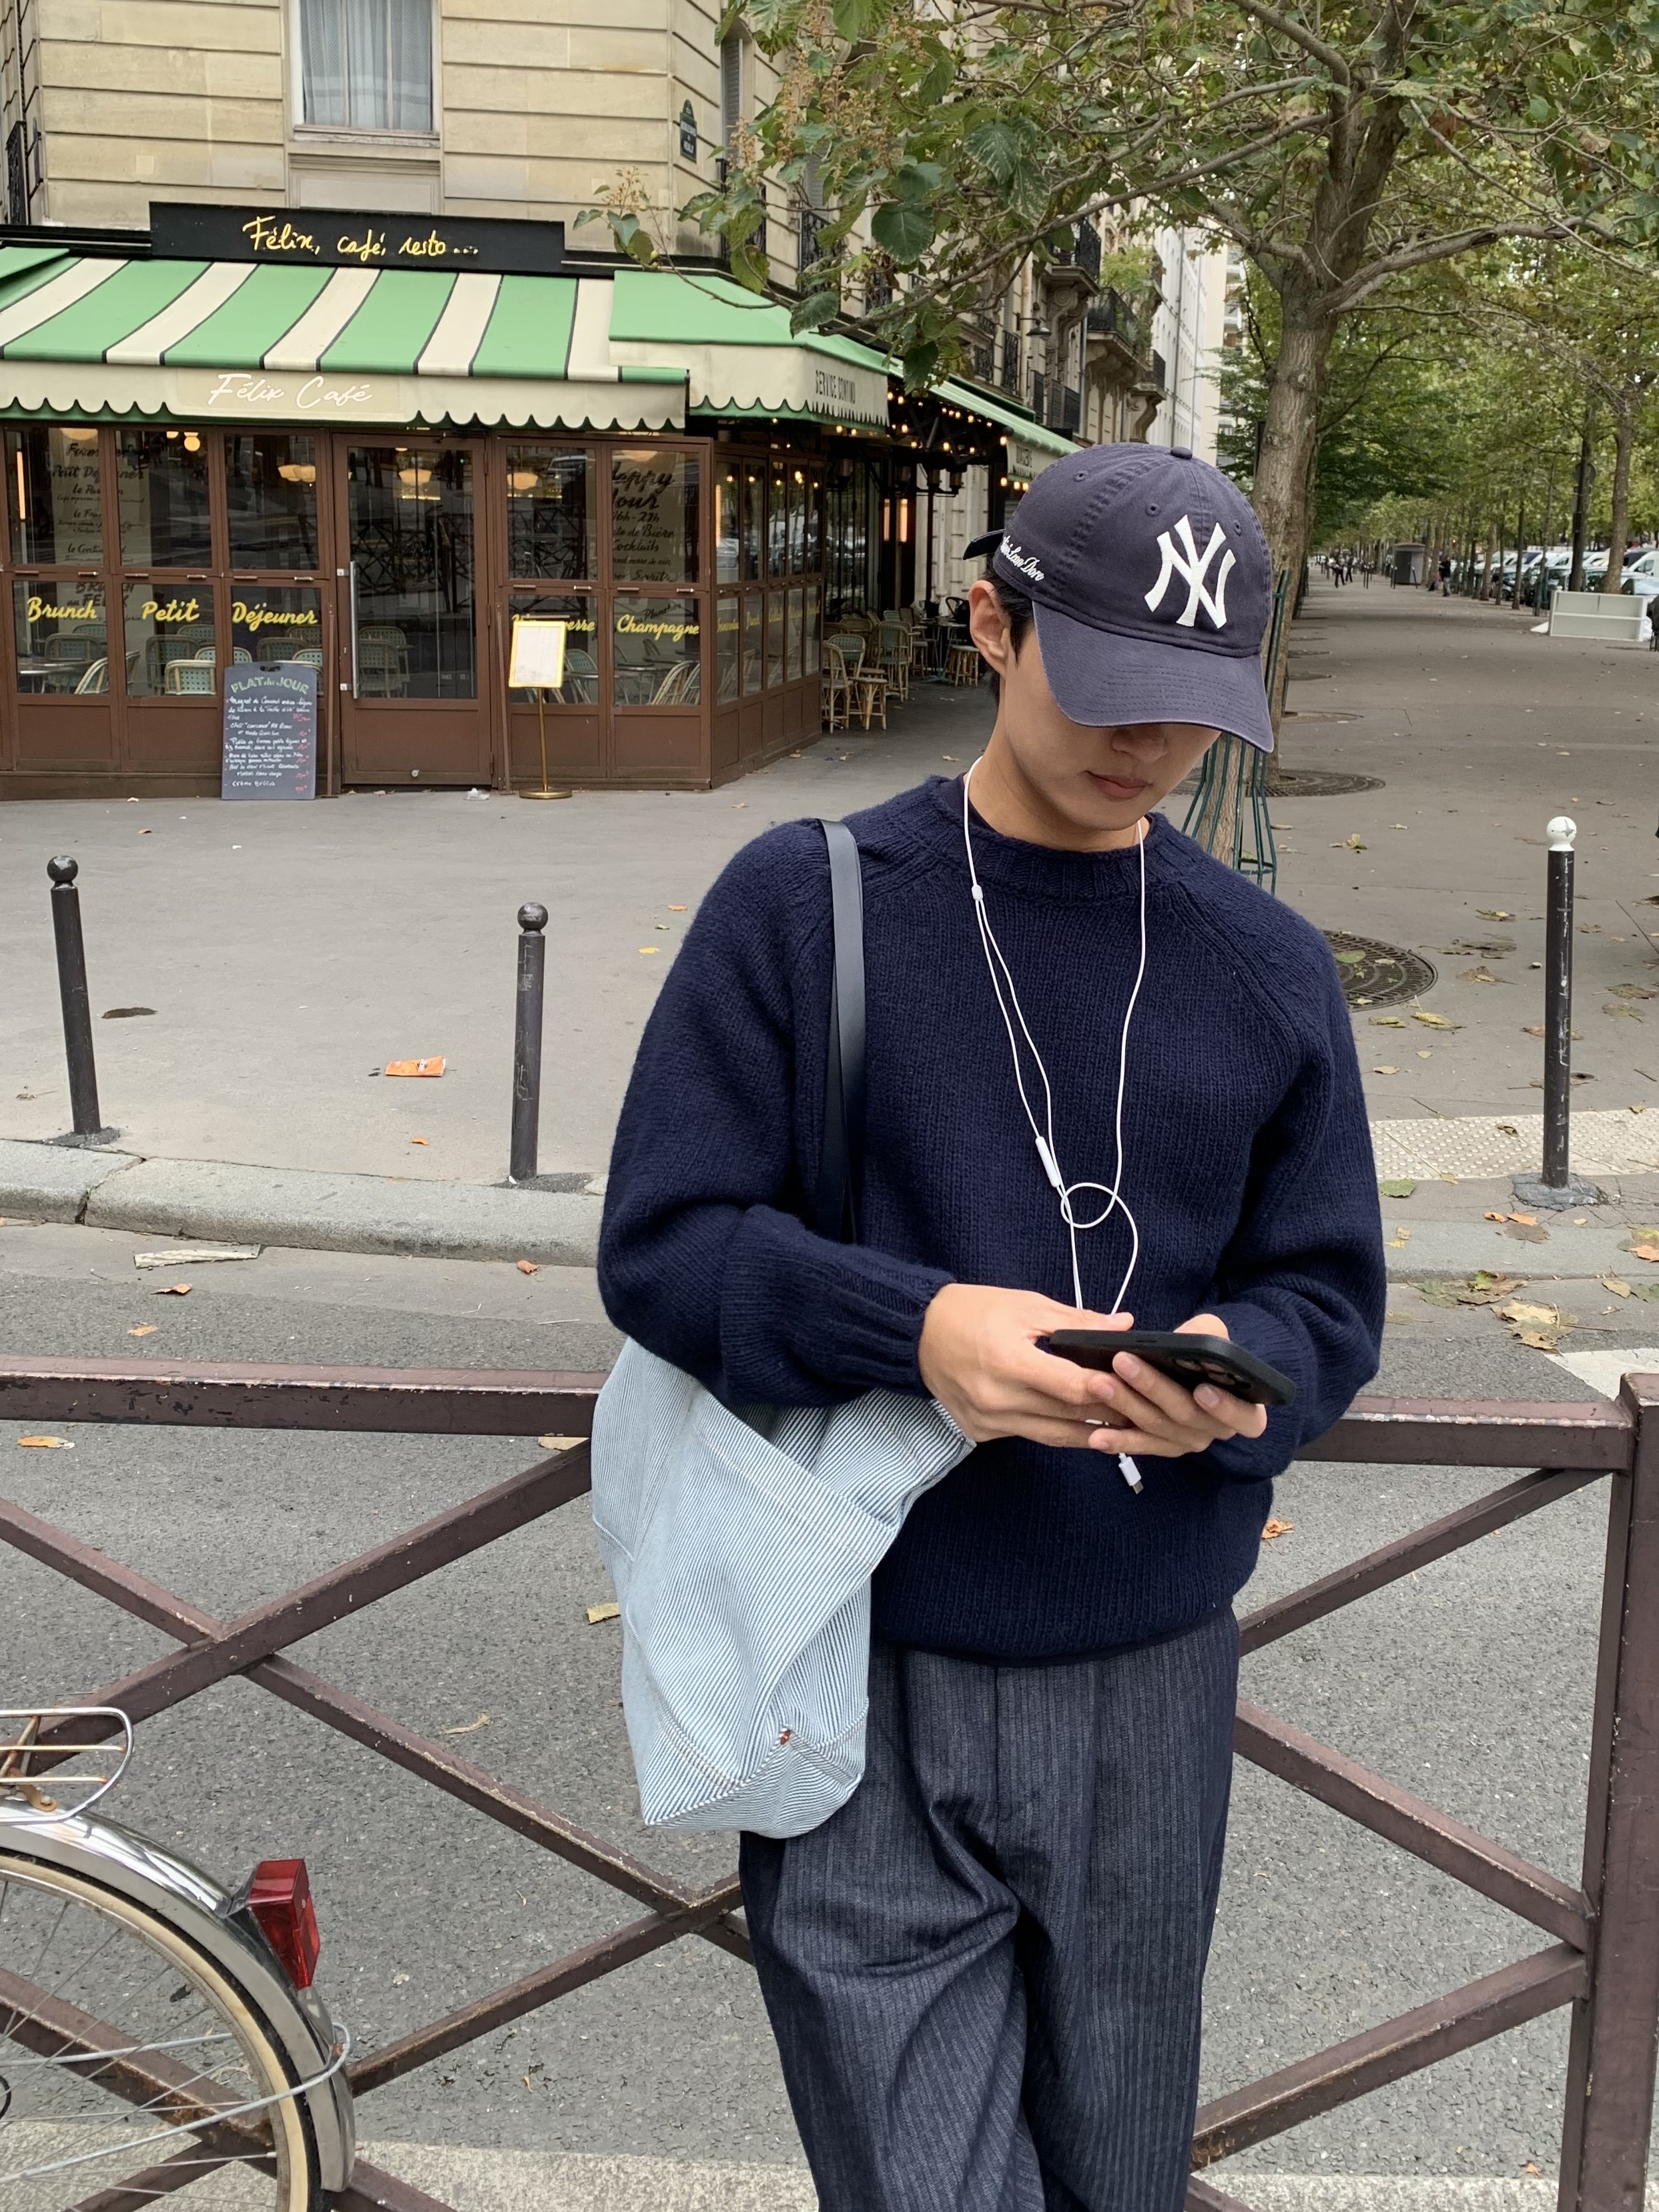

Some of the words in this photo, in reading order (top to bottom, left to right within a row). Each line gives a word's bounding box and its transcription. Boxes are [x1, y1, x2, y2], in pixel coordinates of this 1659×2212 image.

[242, 215, 320, 255] Félix,
[337, 229, 386, 261] café,
[208, 373, 285, 405] Félix
[296, 376, 373, 408] Café
[612, 488, 659, 510] our
[1144, 514, 1237, 629] NY
[27, 596, 97, 623] Brunch
[141, 598, 200, 621] Petit
[232, 601, 318, 631] Déjeuner
[566, 619, 595, 631] erre
[616, 614, 699, 641] Champagne
[231, 677, 264, 693] PLAT
[276, 677, 309, 694] JOUR
